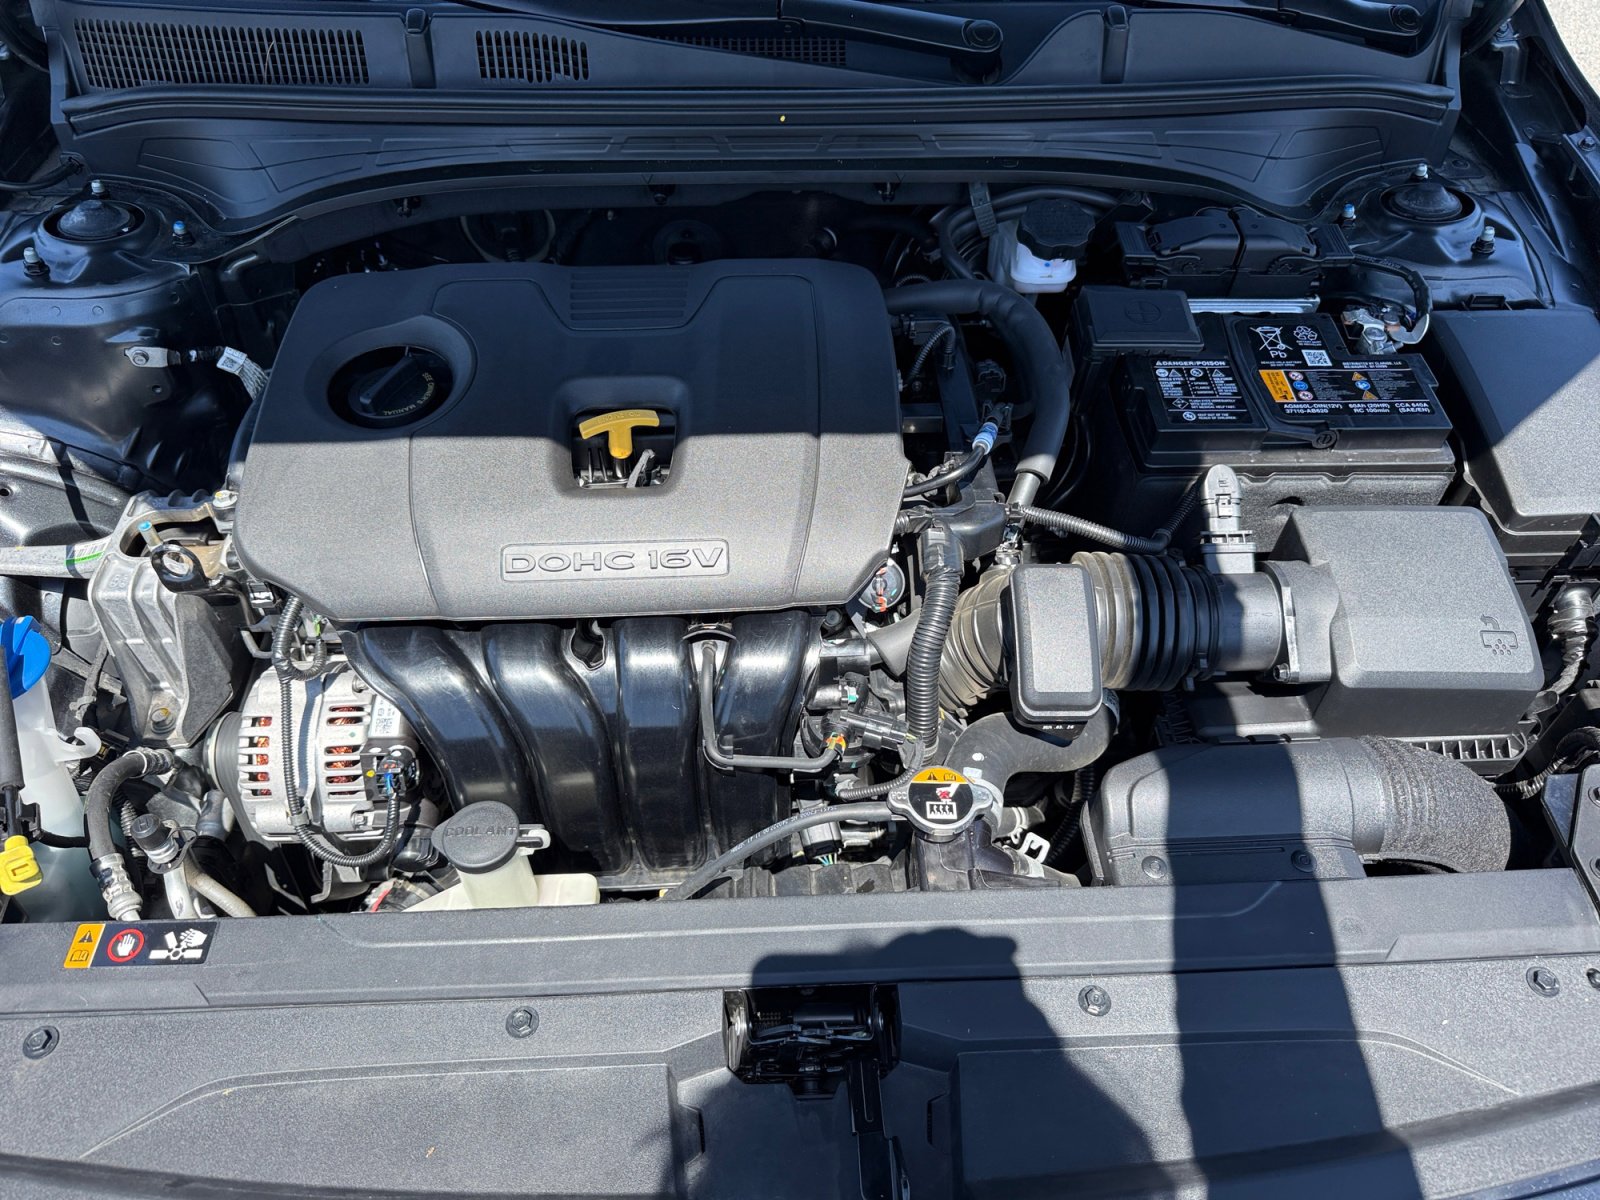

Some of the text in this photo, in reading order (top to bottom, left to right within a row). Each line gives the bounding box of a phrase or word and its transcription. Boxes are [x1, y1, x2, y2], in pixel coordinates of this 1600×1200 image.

[504, 548, 724, 573] DOHC 16V
[446, 826, 517, 837] COOLANT
